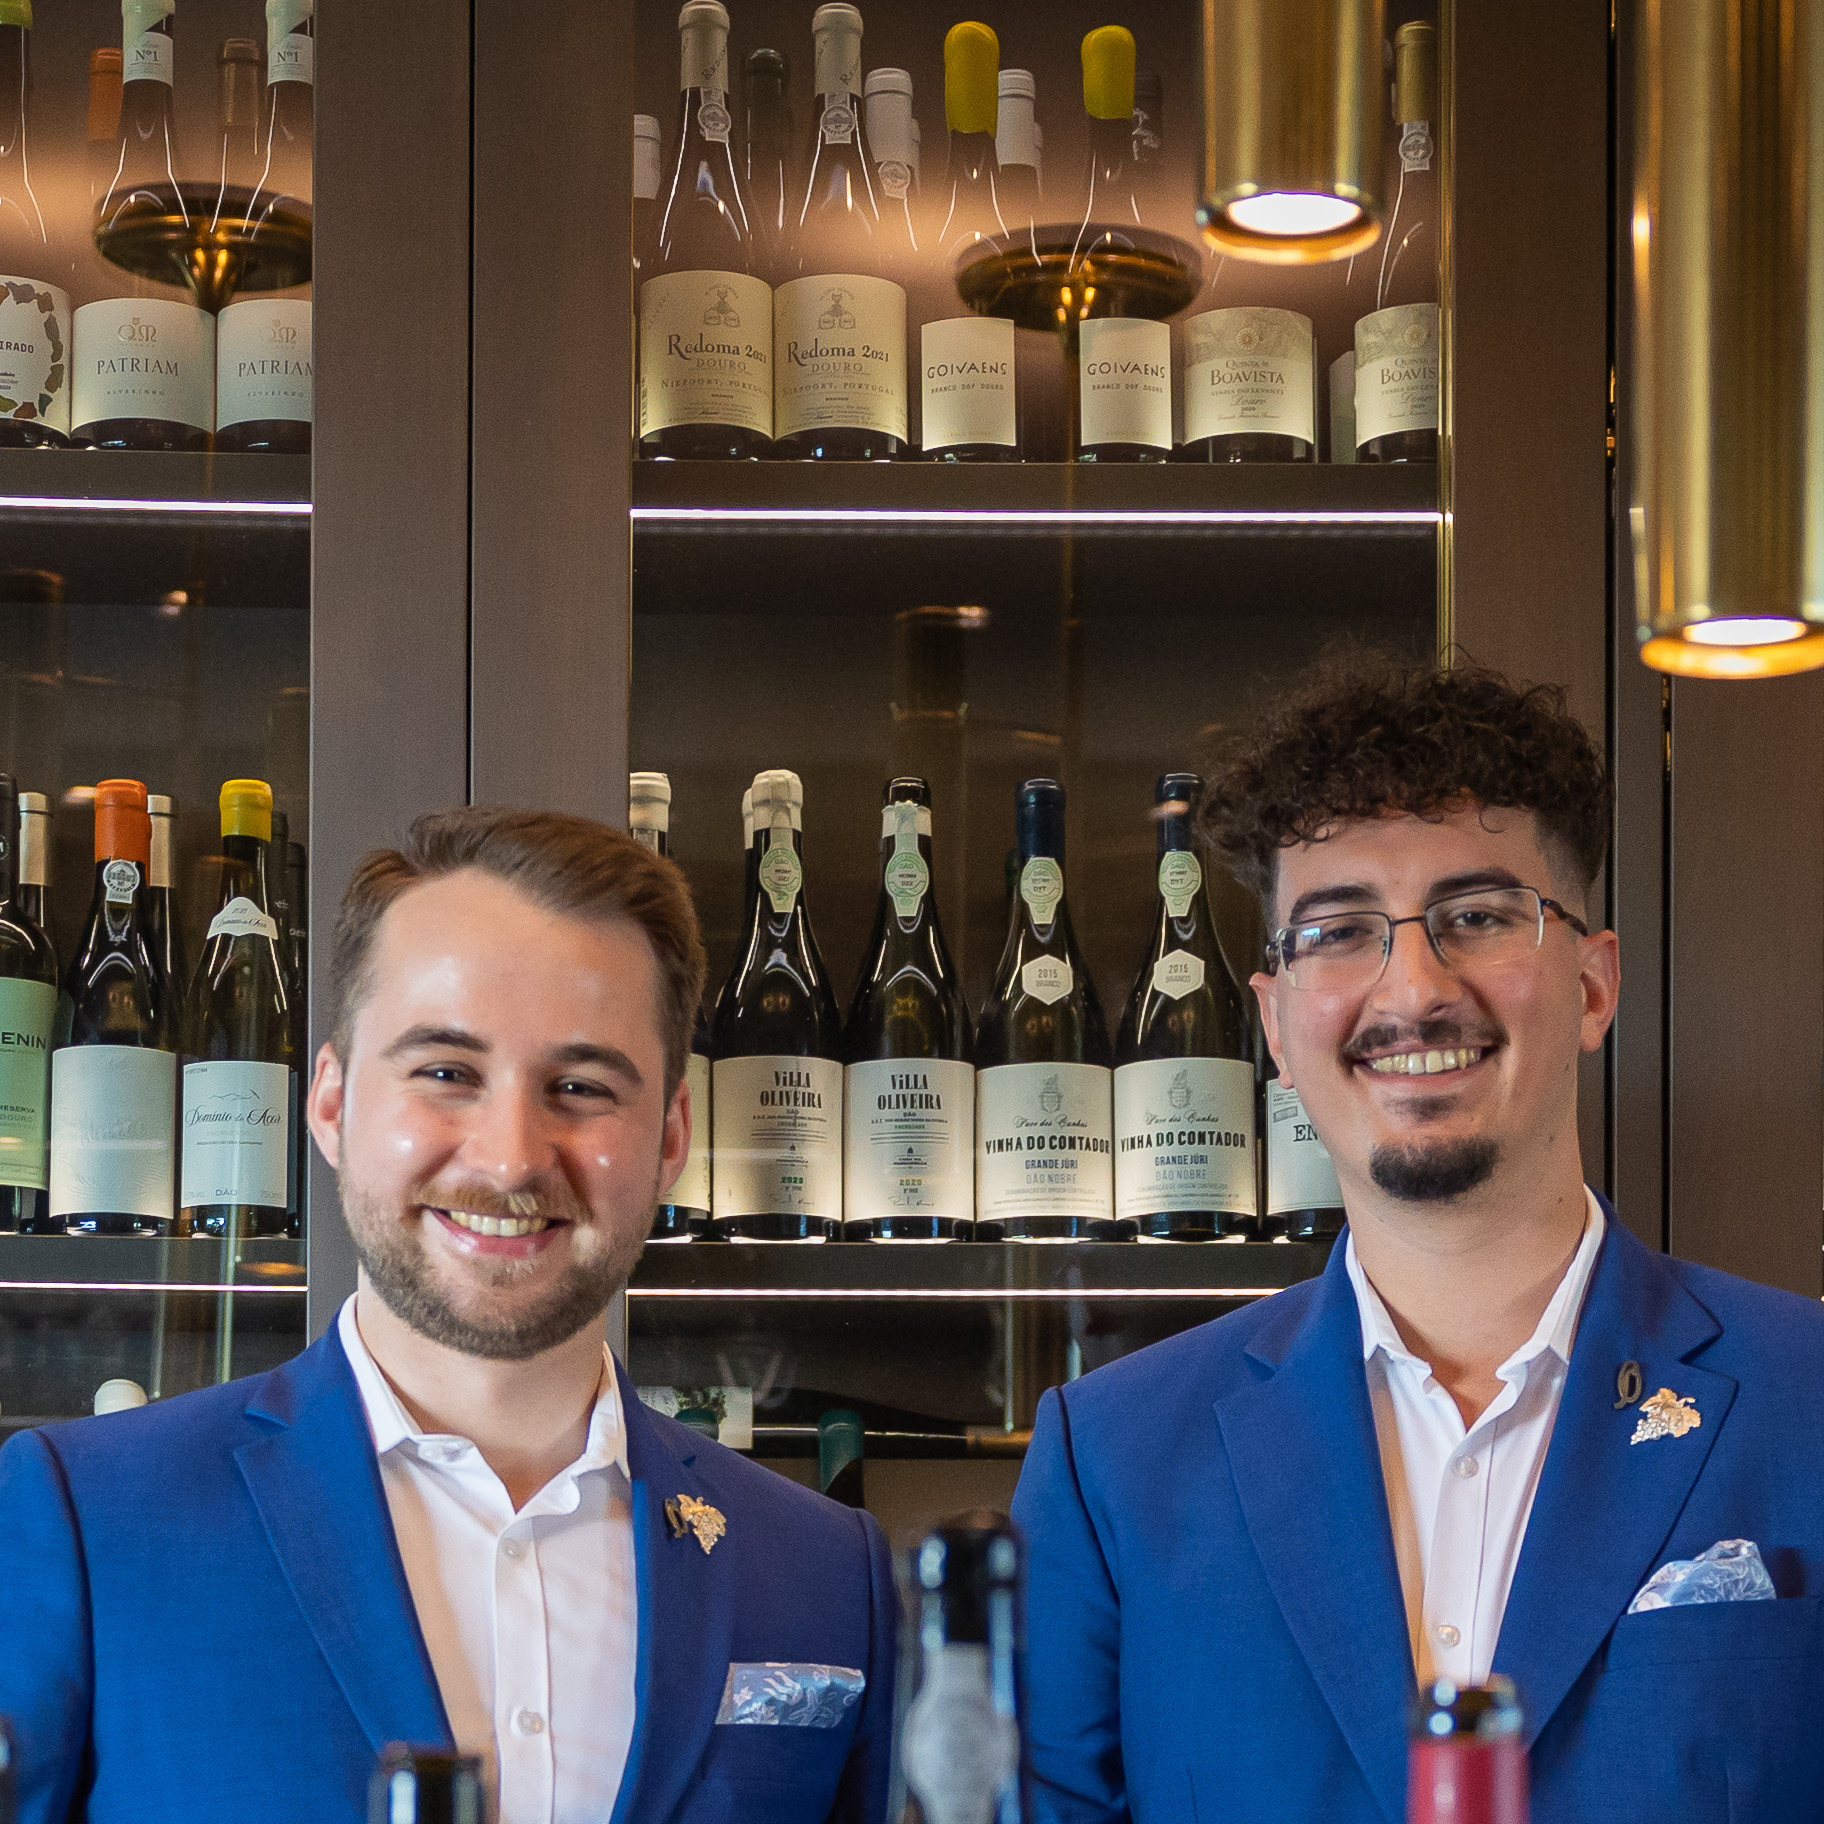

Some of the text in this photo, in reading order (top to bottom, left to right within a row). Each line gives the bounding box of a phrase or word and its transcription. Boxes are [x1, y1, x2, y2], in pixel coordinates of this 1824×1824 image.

[668, 333, 767, 365] Redoma 2021
[787, 338, 890, 367] Redoma 2021
[97, 357, 179, 377] PATRIAM
[927, 362, 1007, 379] GOIVAENS
[1087, 362, 1165, 379] GOIVAENS
[1211, 369, 1284, 386] BOAVISTA
[1038, 968, 1058, 978] 2015
[1168, 963, 1188, 974] 2015
[759, 1090, 822, 1109] OLIVEIRA
[877, 1093, 942, 1110] OLIVEIRA
[985, 1135, 1110, 1155] VINHA DO CONTADOR
[1121, 1130, 1246, 1153] VINHA DO CONTADOR
[1024, 1157, 1078, 1170] GRANDE JÚRI
[1155, 1153, 1208, 1167] GRANDE JÚRI
[1026, 1172, 1077, 1184] DÃO NOBRE
[1155, 1168, 1207, 1181] DÃO NOBRE
